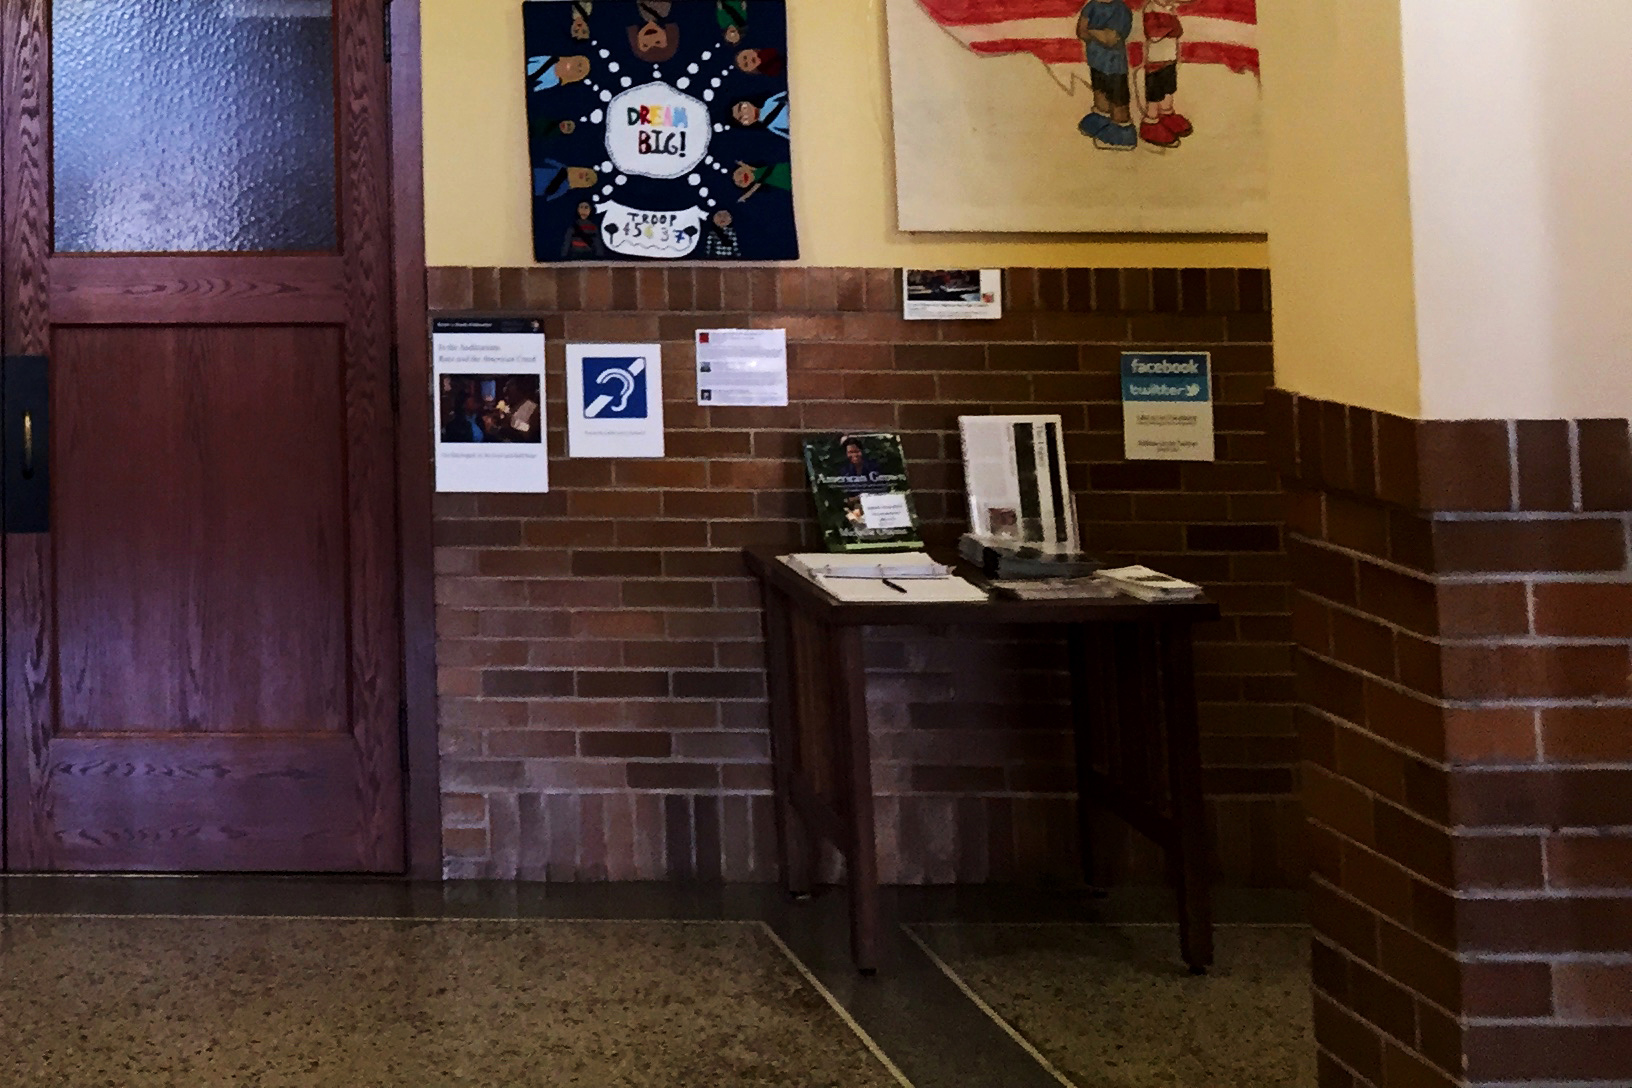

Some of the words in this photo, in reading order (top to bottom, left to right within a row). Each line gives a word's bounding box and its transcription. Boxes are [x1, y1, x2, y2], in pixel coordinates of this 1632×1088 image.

[627, 104, 689, 129] DREAM
[638, 129, 687, 158] BIG!
[627, 212, 677, 227] TROOP
[1131, 358, 1199, 374] facebook
